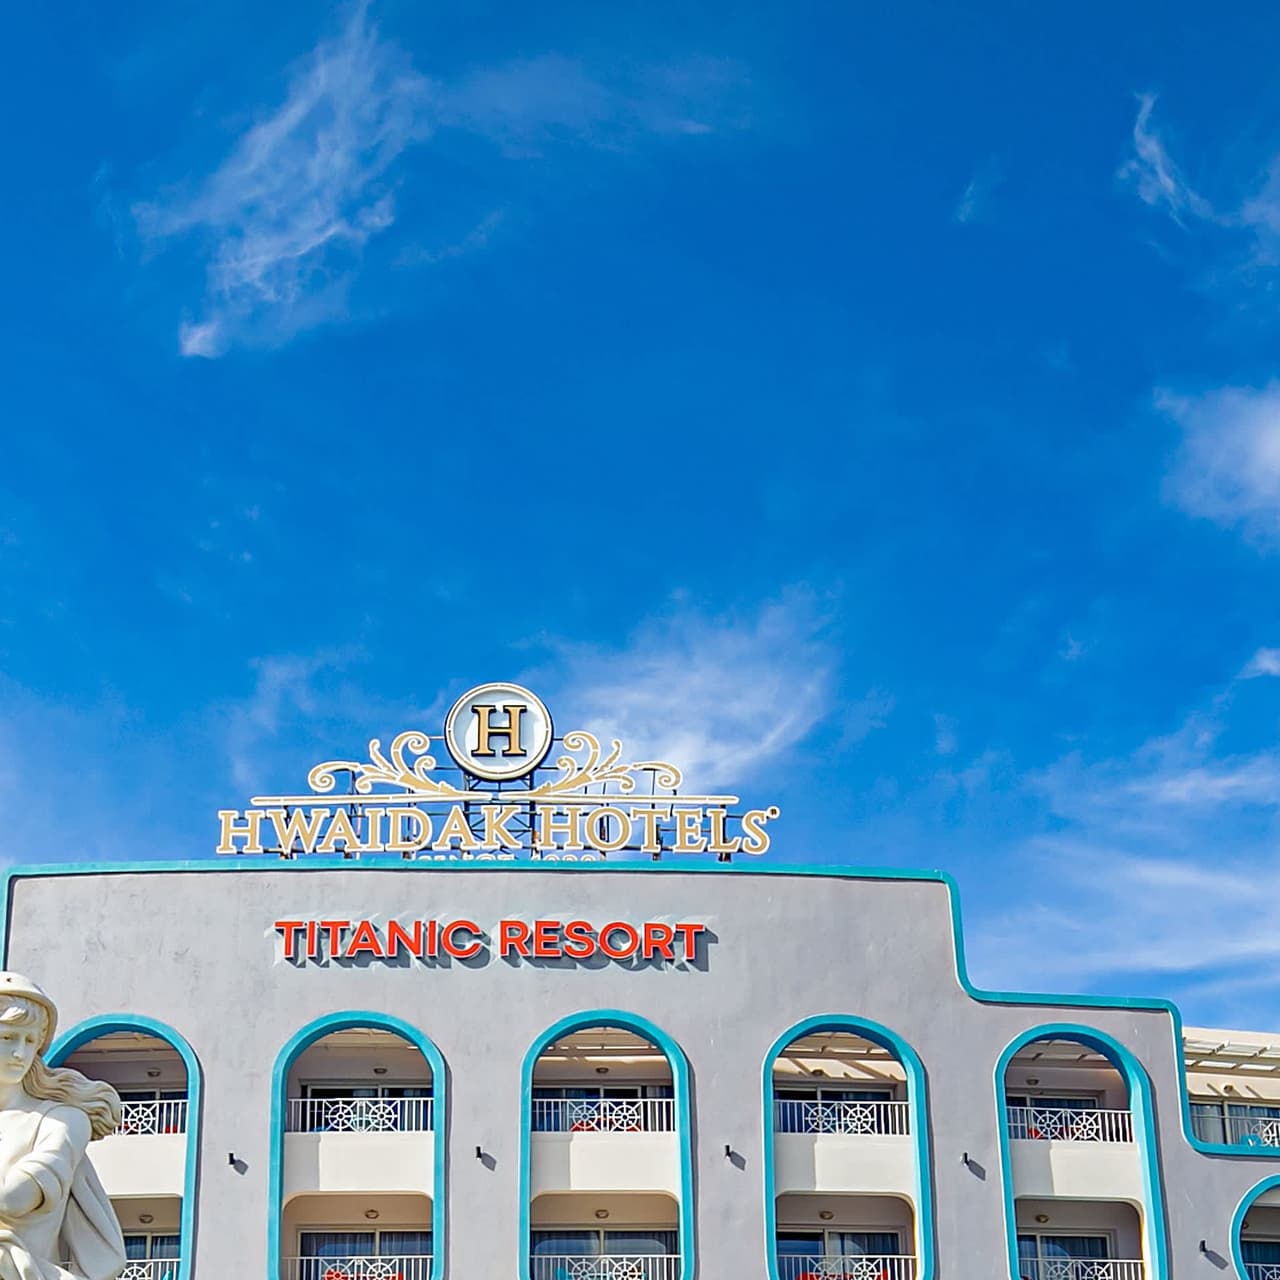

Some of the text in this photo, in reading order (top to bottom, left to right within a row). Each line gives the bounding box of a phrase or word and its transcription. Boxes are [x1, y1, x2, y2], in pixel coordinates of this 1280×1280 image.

[471, 704, 527, 757] H
[217, 804, 771, 854] HWAIDAK HOTELS
[274, 920, 706, 960] TITANIC RESORT
